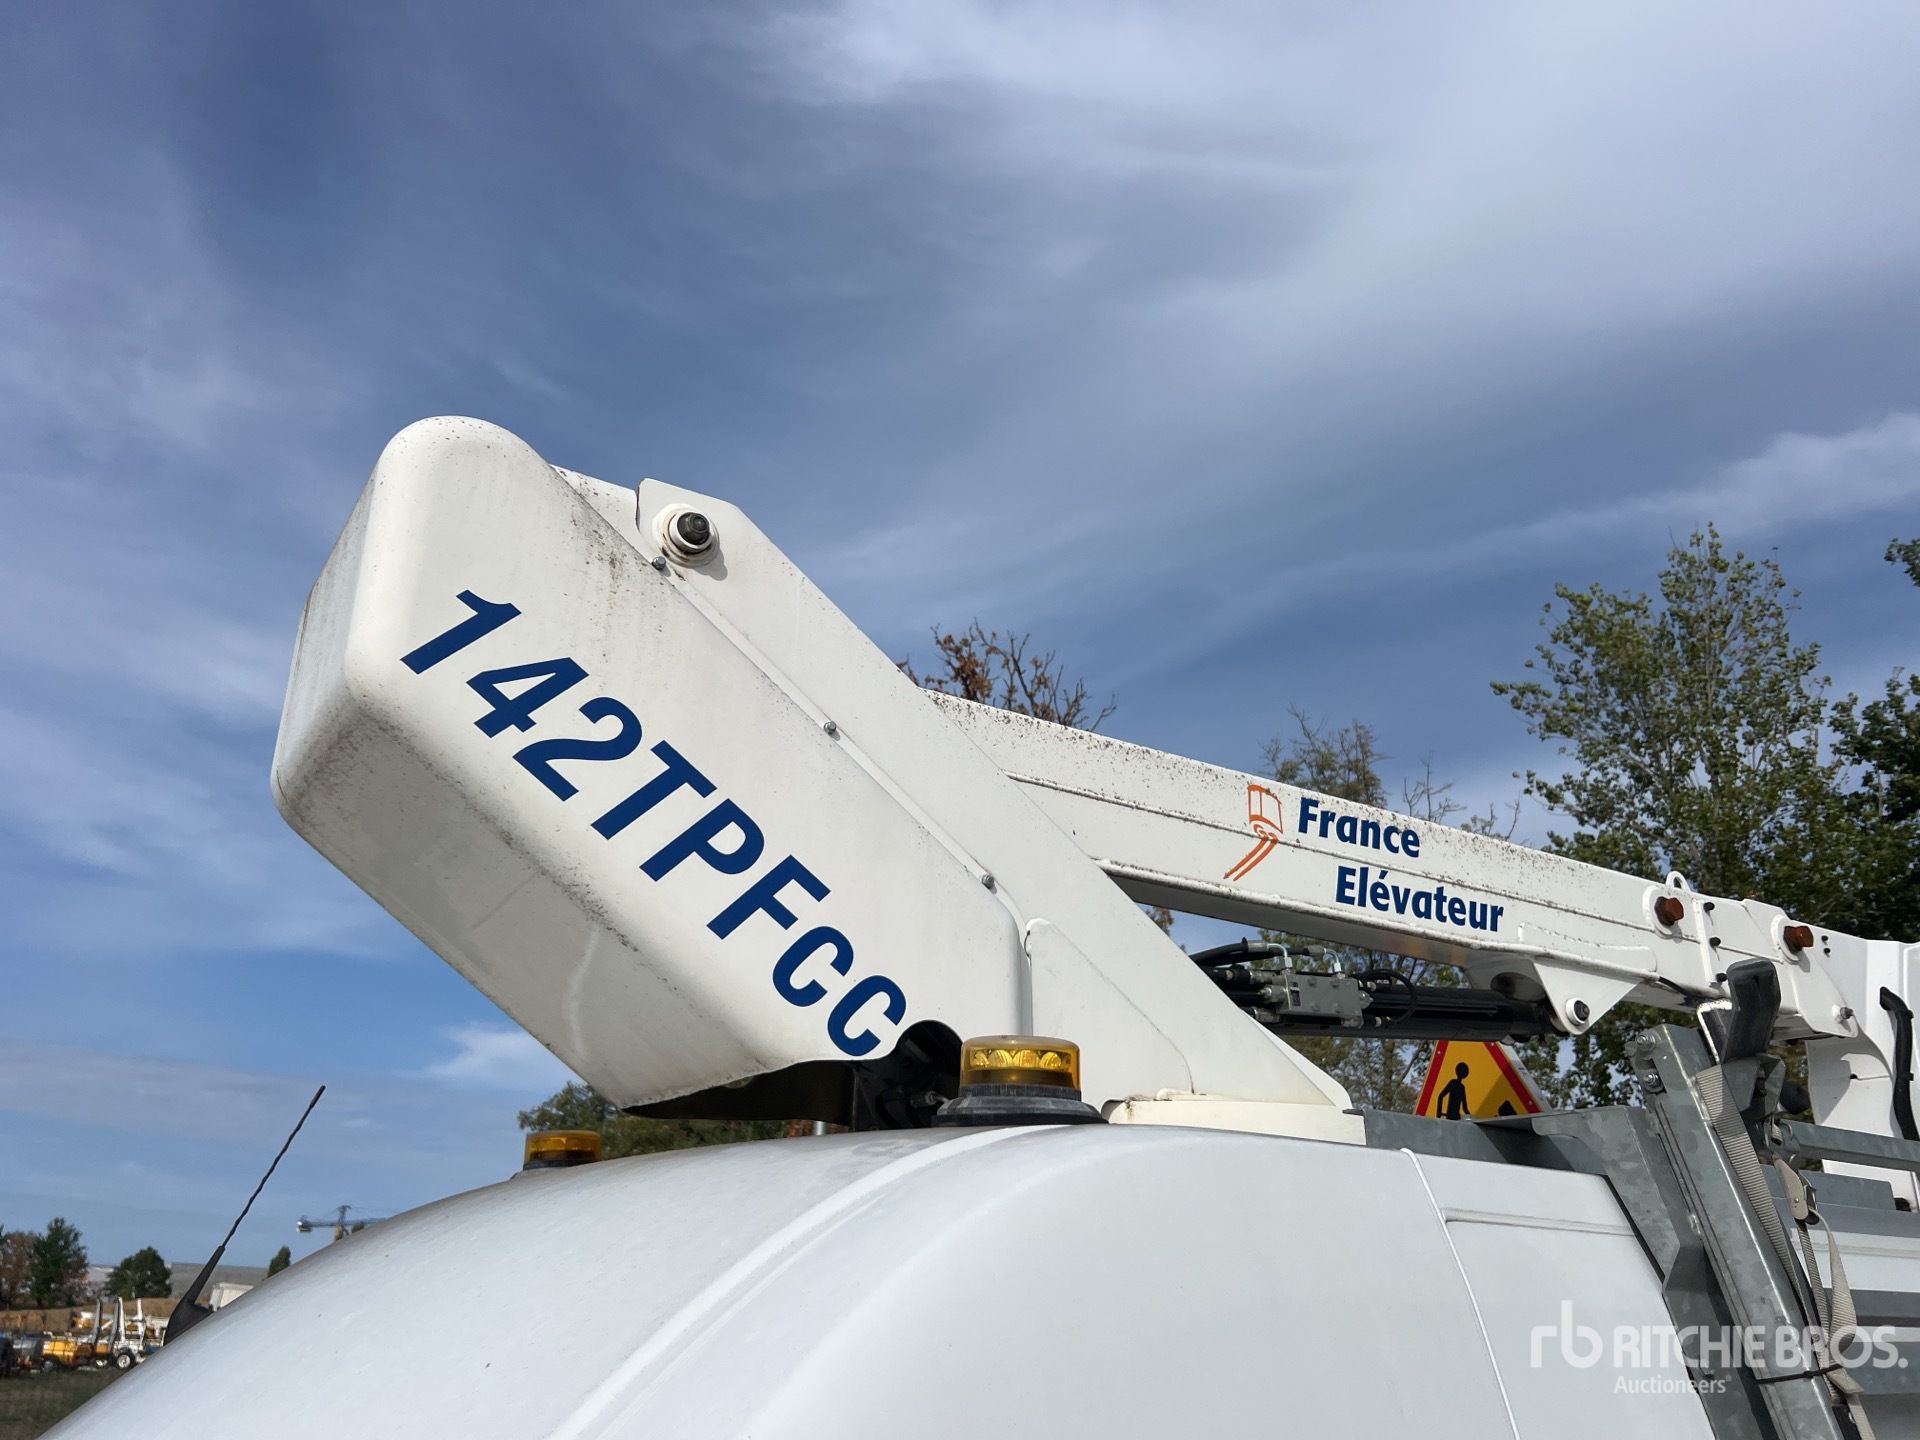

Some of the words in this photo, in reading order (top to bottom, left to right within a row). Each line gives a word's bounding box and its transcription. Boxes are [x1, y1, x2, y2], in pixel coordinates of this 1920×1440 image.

[400, 589, 907, 1056] 142TPFCC
[1299, 797, 1420, 858] France
[1336, 865, 1504, 932] Elévateur
